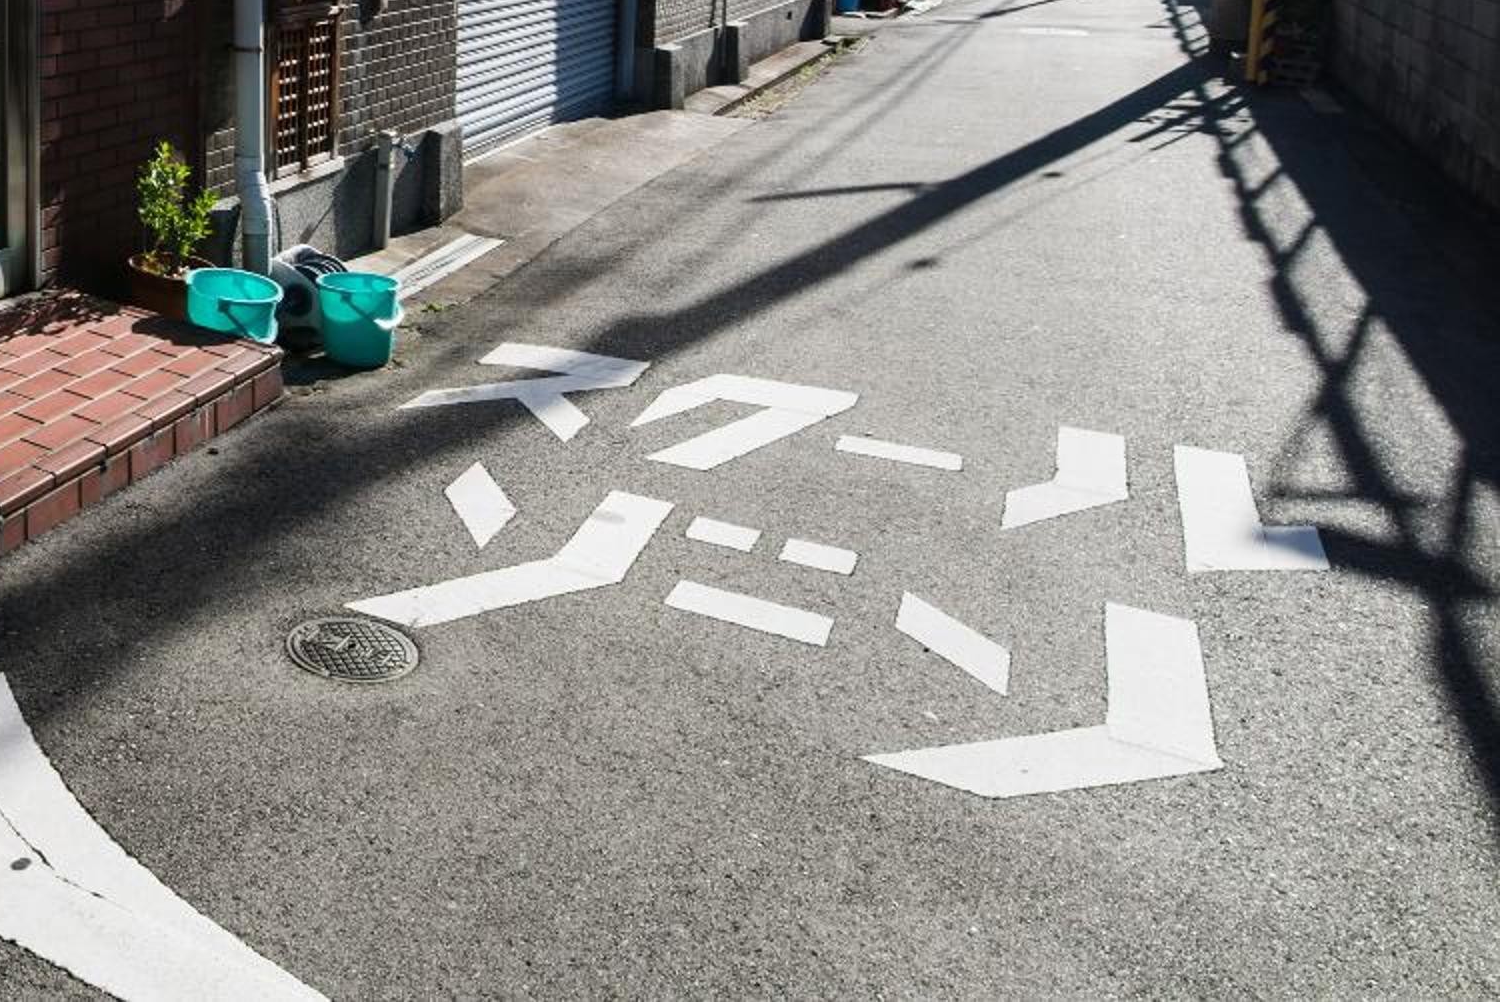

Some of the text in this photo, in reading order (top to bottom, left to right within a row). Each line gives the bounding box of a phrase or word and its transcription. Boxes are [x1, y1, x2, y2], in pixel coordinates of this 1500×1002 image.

[400, 342, 1330, 572] スクール
[345, 462, 1222, 799] ゾーン
